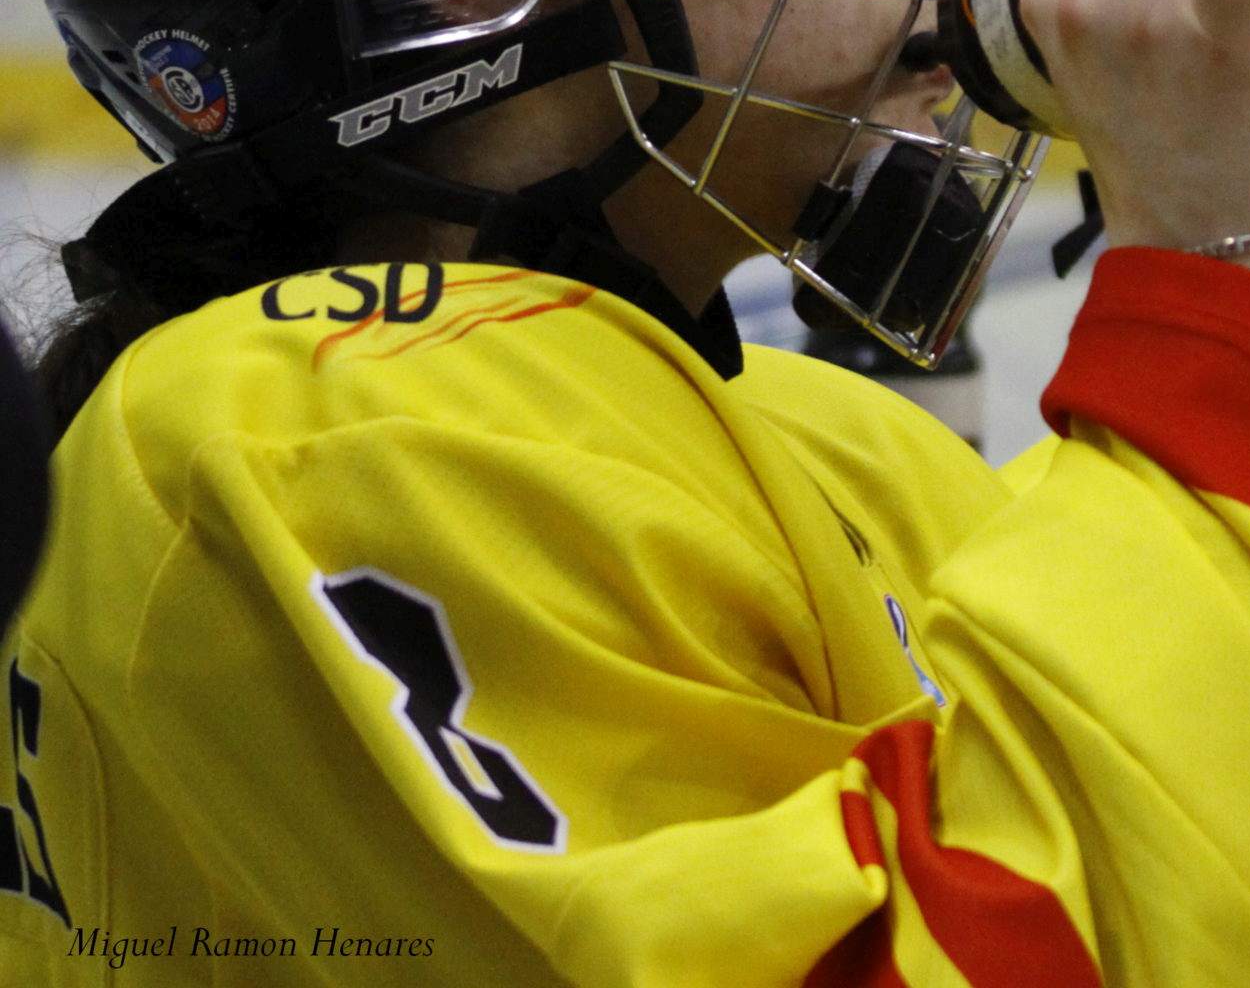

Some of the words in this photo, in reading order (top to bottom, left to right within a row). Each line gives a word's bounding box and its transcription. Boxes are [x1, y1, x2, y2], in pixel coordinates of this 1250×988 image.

[171, 30, 210, 51] HELMET
[328, 43, 523, 149] CCM
[261, 262, 444, 323] CSD
